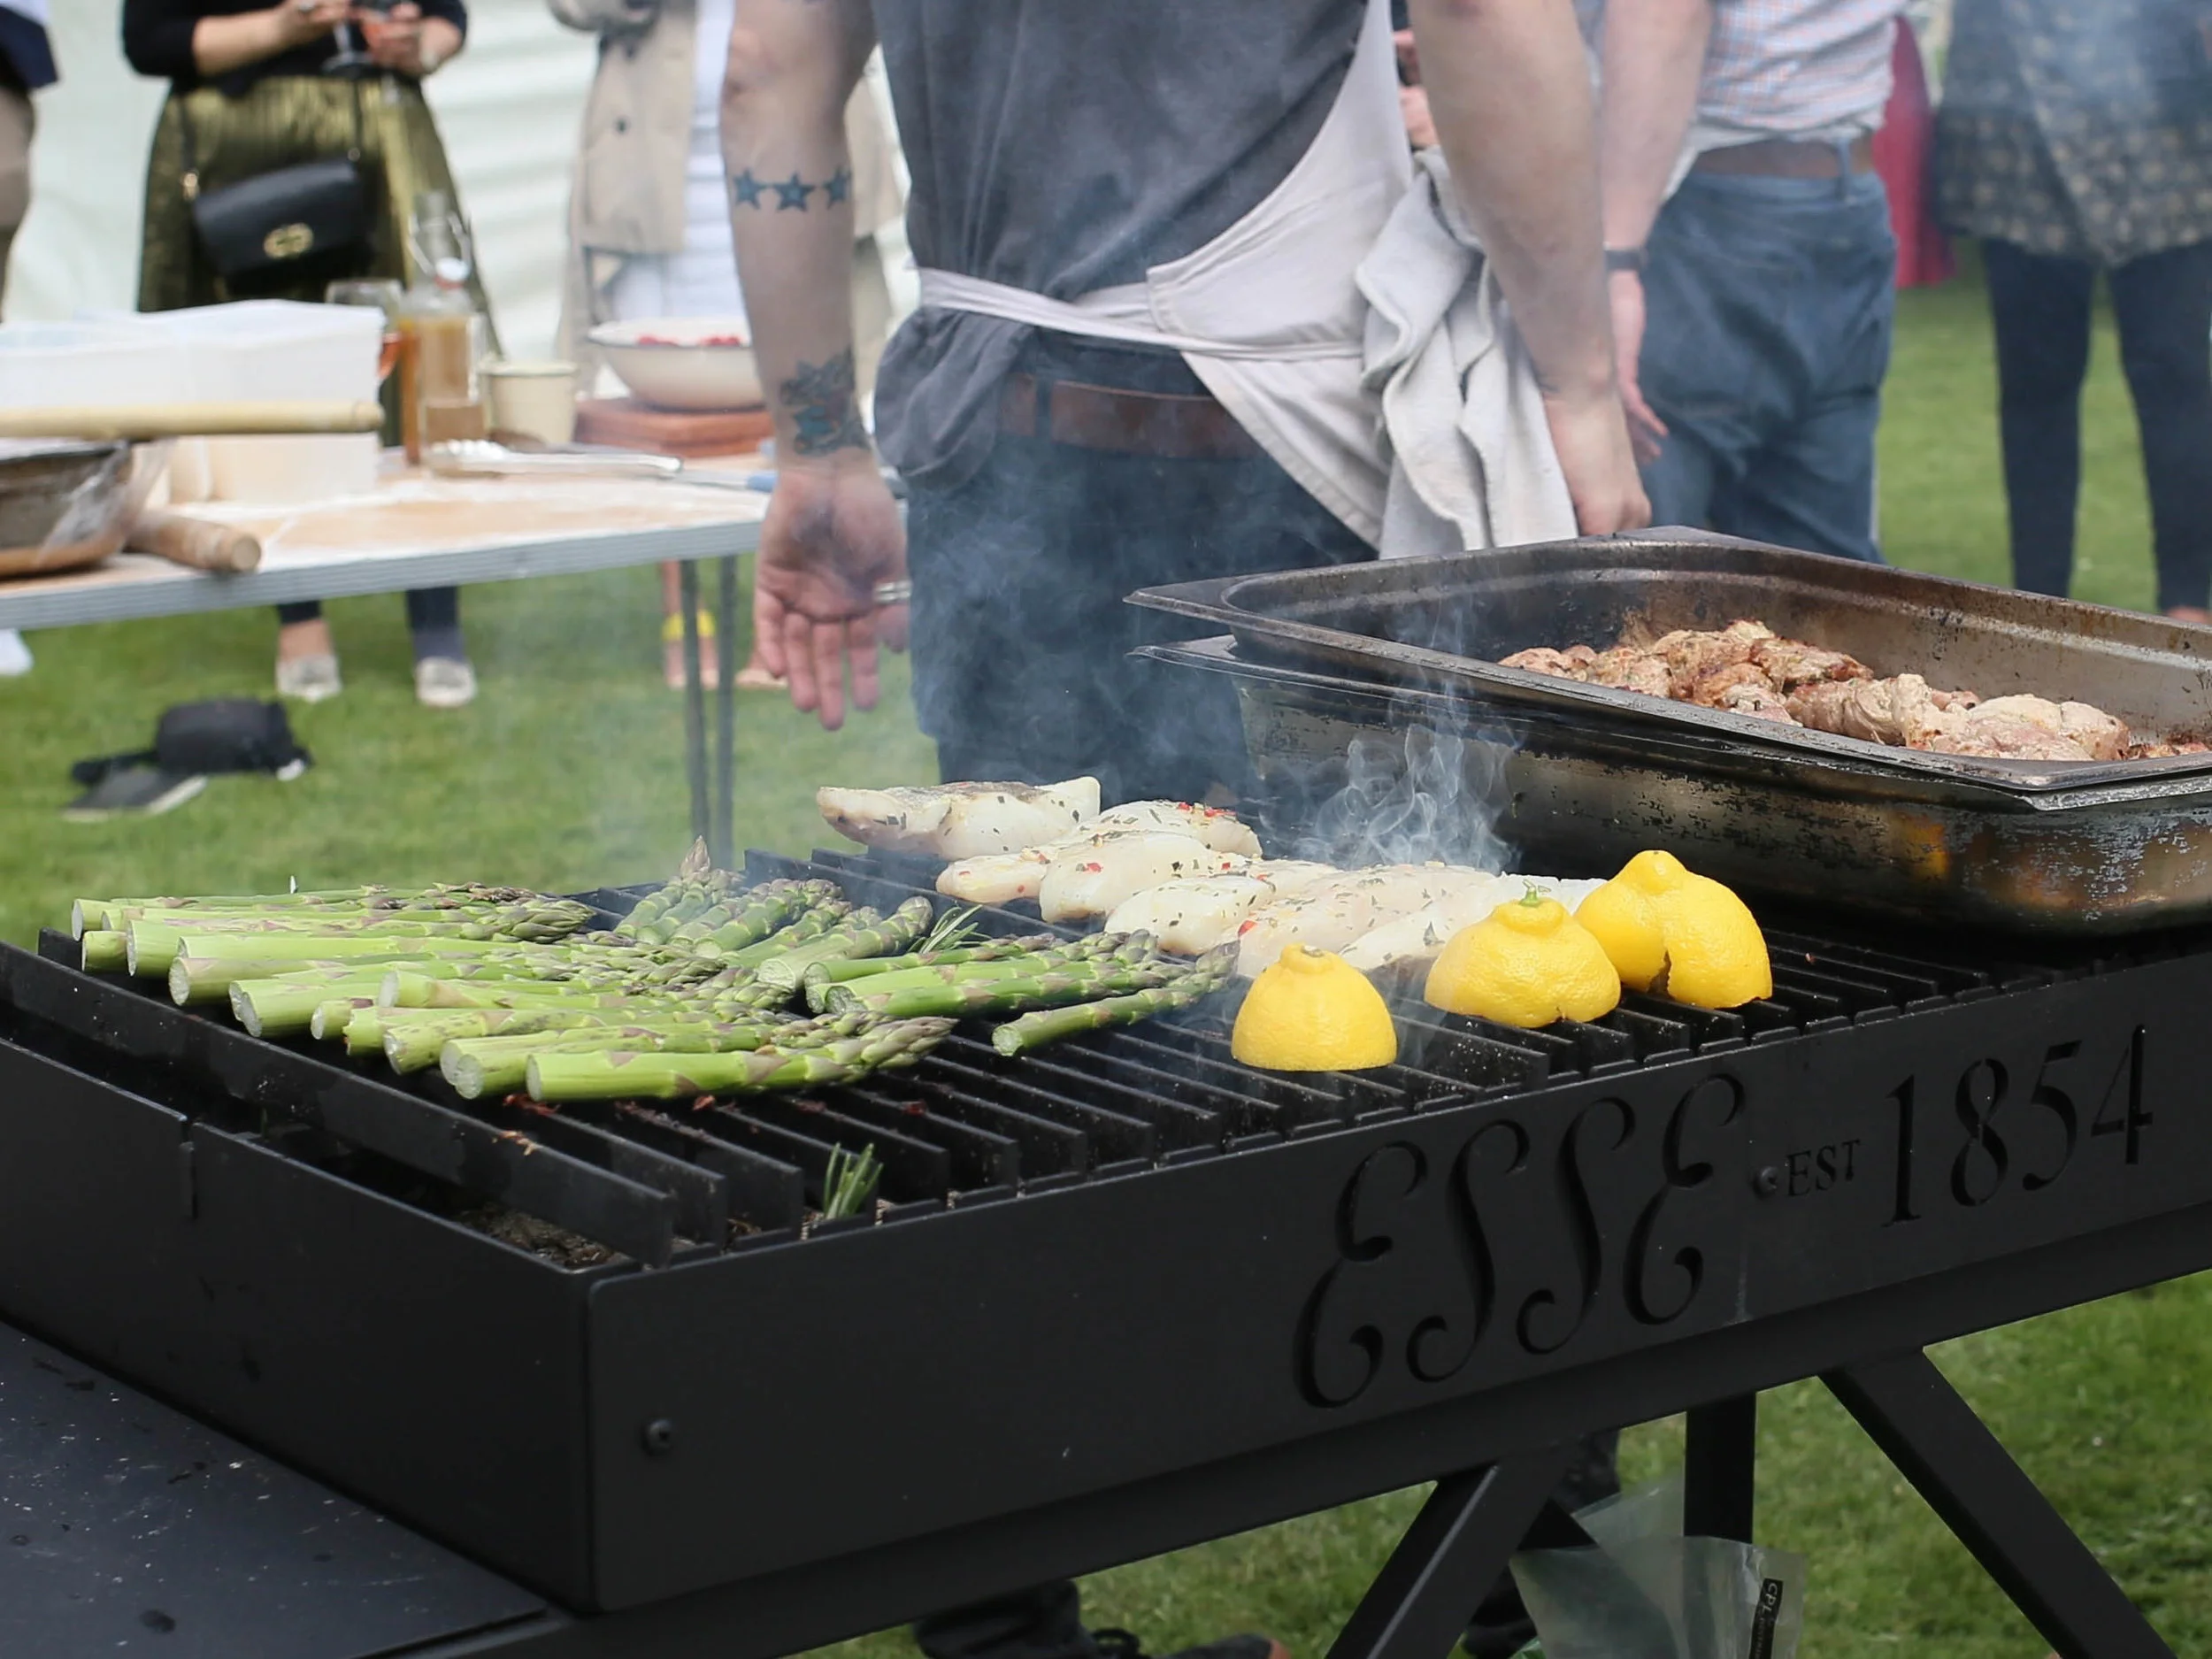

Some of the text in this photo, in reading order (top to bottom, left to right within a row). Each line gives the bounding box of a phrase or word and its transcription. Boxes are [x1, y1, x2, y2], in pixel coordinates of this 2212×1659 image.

[1293, 1024, 2154, 1409] ESSE EST 1854
